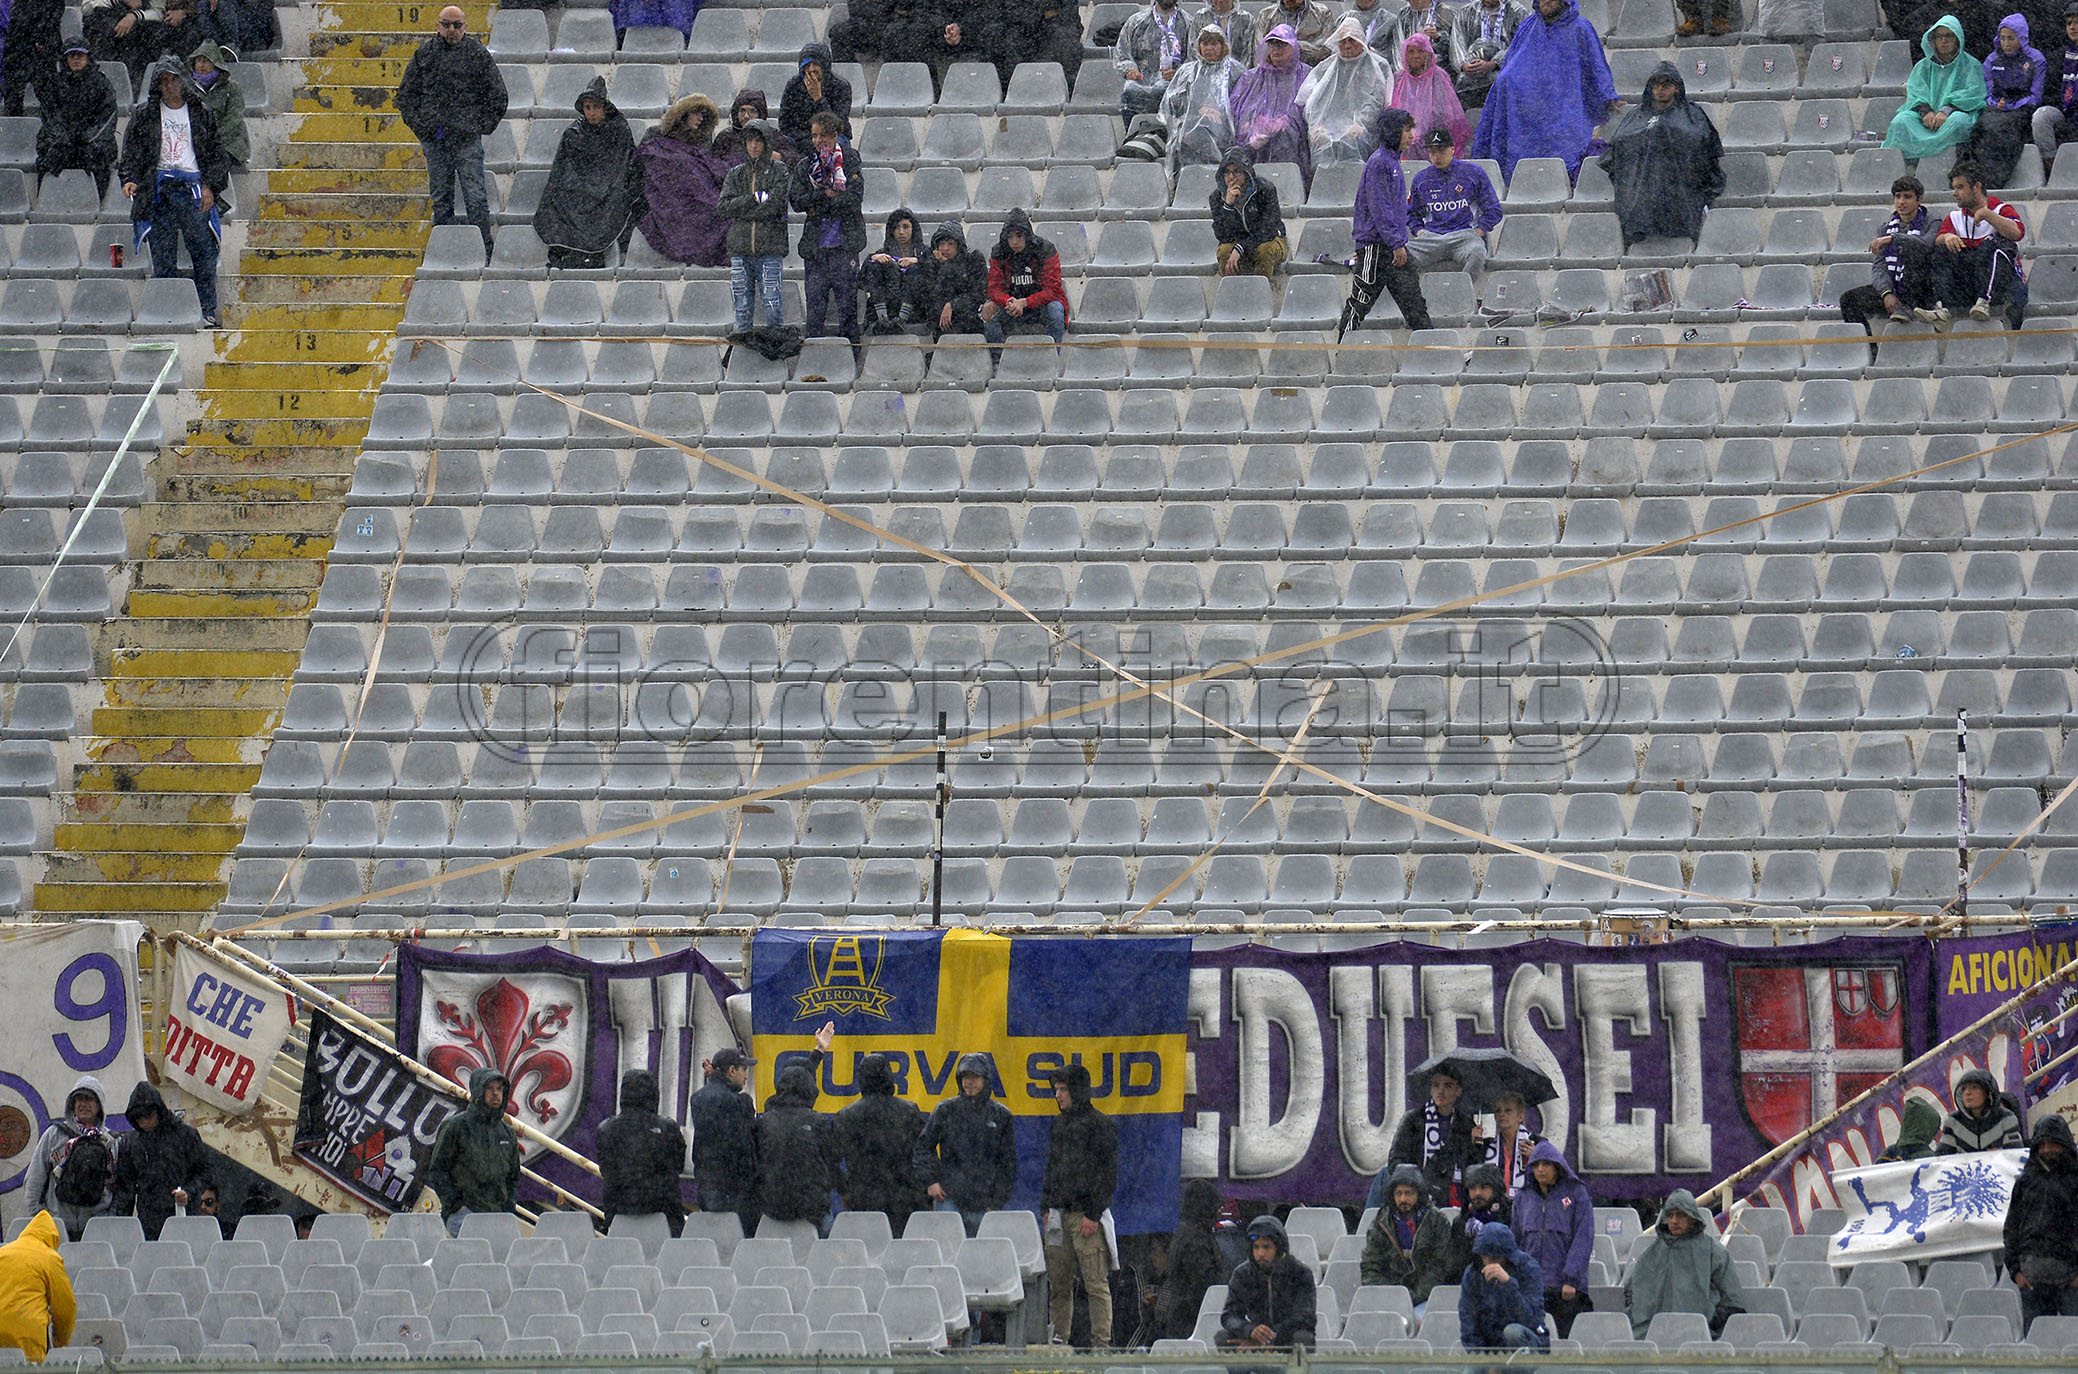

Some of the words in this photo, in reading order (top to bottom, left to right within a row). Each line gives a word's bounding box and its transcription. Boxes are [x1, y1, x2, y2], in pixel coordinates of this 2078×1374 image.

[397, 7, 419, 23] 19
[1427, 199, 1469, 212] TOYOTA
[295, 334, 317, 351] 13
[279, 394, 300, 411] 12
[815, 989, 869, 1002] VERONA
[52, 952, 127, 1072] 9
[186, 971, 266, 1040] CHE
